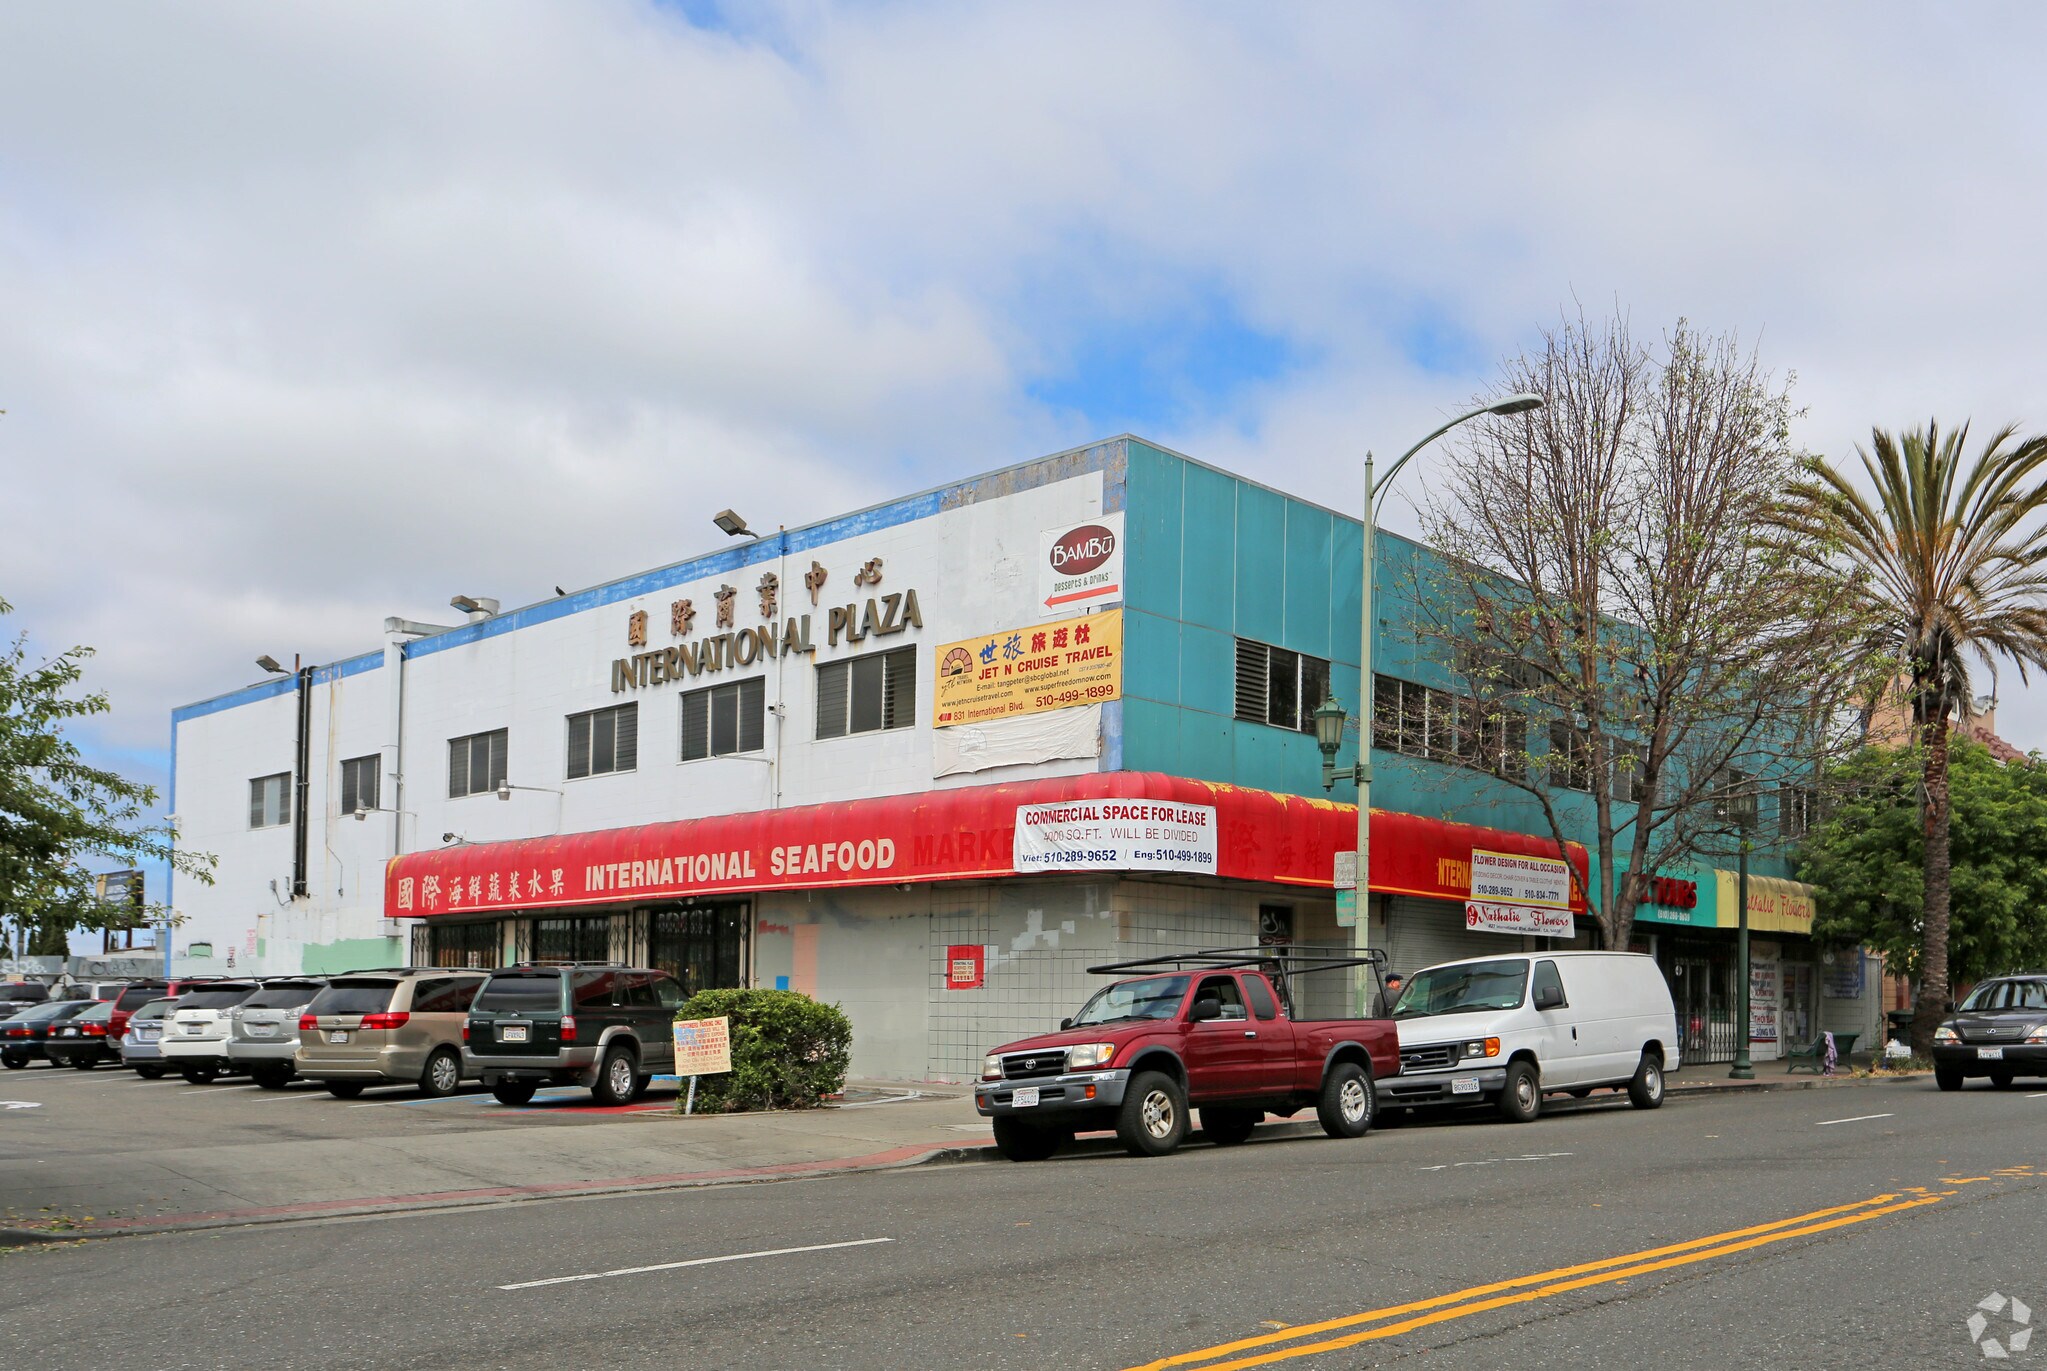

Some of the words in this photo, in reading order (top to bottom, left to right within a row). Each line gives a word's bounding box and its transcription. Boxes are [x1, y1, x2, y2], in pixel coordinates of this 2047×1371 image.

[611, 614, 815, 693] INTERNATIONAL
[828, 588, 922, 646] PLAZA
[979, 667, 998, 680] JET
[1005, 664, 1011, 675] N
[1017, 655, 1058, 672] CRUISE
[1066, 645, 1112, 663] TRAVEL
[1024, 673, 1111, 693] www.superfreedomnow.com
[954, 711, 964, 720] 831
[968, 704, 1005, 718] International
[1009, 701, 1024, 712] Blvd.
[1036, 684, 1113, 707] 510-499-1899
[1026, 807, 1099, 825] COMMERCIAL
[1103, 805, 1148, 820] SPACE
[1152, 807, 1174, 822] FOR
[1176, 809, 1206, 826] LEASE
[1110, 828, 1141, 839] WILL
[1146, 827, 1159, 839] BE
[1163, 828, 1198, 842] DIVIDED
[585, 850, 756, 892] INTERNATIONAL
[770, 837, 896, 876] SEAFOOD
[914, 828, 1014, 866] MARKE
[1044, 849, 1116, 863] 510-289-9652
[1156, 849, 1212, 863] 510-499-1899
[1474, 855, 1496, 866] FLOWER
[1498, 858, 1517, 868] DESIGN
[1518, 860, 1529, 869] FOR
[1530, 862, 1539, 871] ALL
[1540, 864, 1566, 874] OCCASION
[398, 868, 564, 911] 國際海鮮蔬菜水果
[1477, 885, 1513, 896] 510-289-9652
[1525, 889, 1559, 900] 510-834-7771
[1650, 876, 1697, 909] TOURS
[1478, 905, 1521, 923] Nathalie
[1530, 910, 1568, 926] Flowers
[1747, 894, 1775, 914] athalie
[1779, 894, 1811, 920] Flowers
